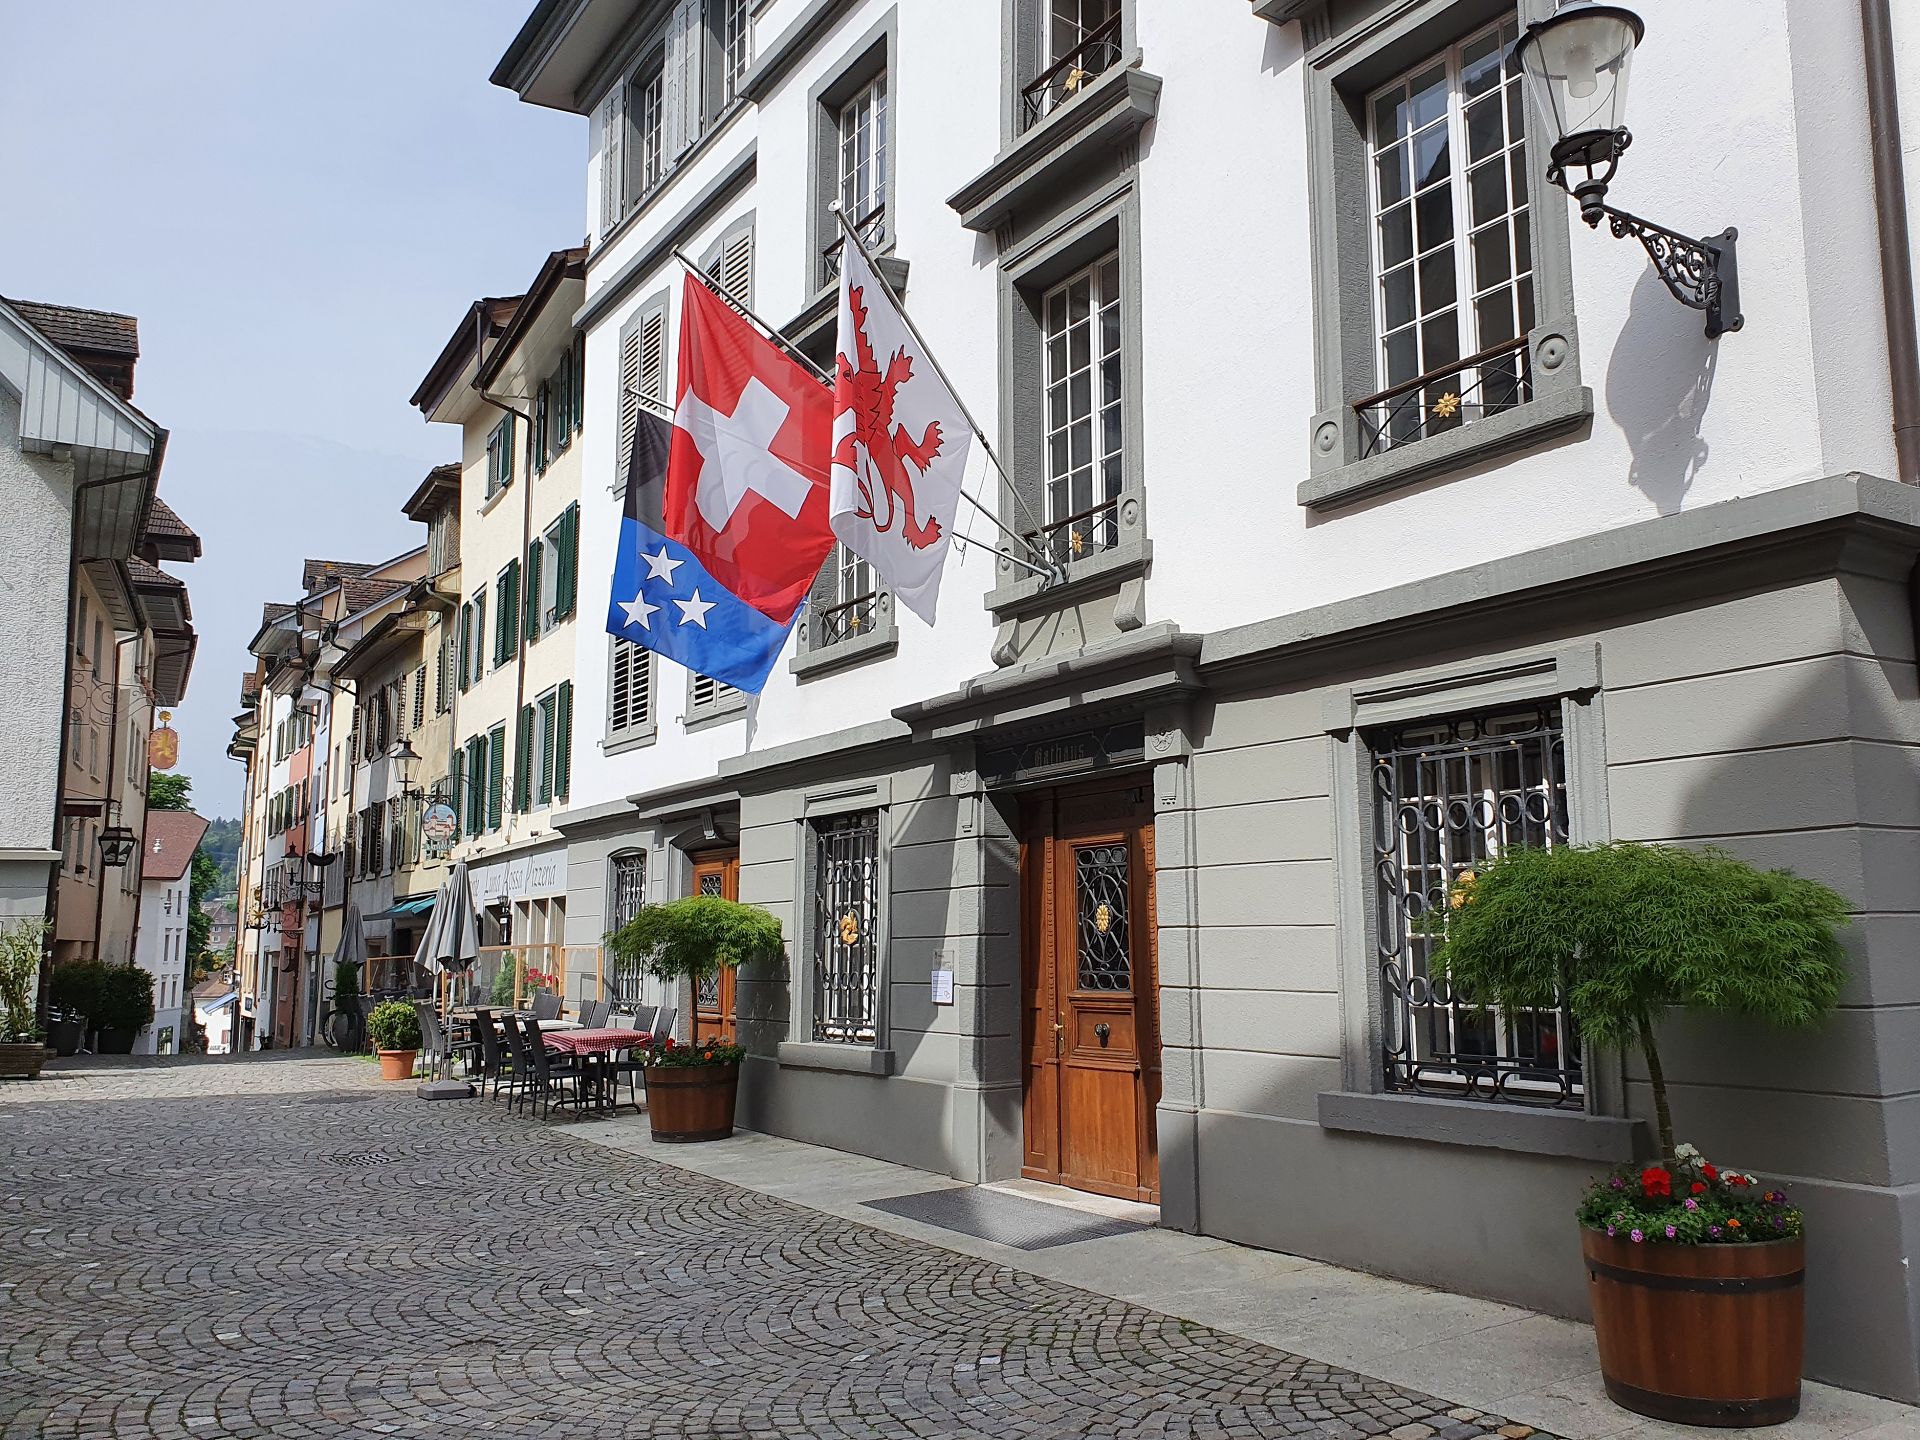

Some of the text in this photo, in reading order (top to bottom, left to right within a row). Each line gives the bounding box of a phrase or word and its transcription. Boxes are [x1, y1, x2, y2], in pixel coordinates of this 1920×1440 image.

[1034, 743, 1085, 767] Rathaus
[502, 861, 523, 895] Rossa
[525, 857, 557, 894] Pizzeria
